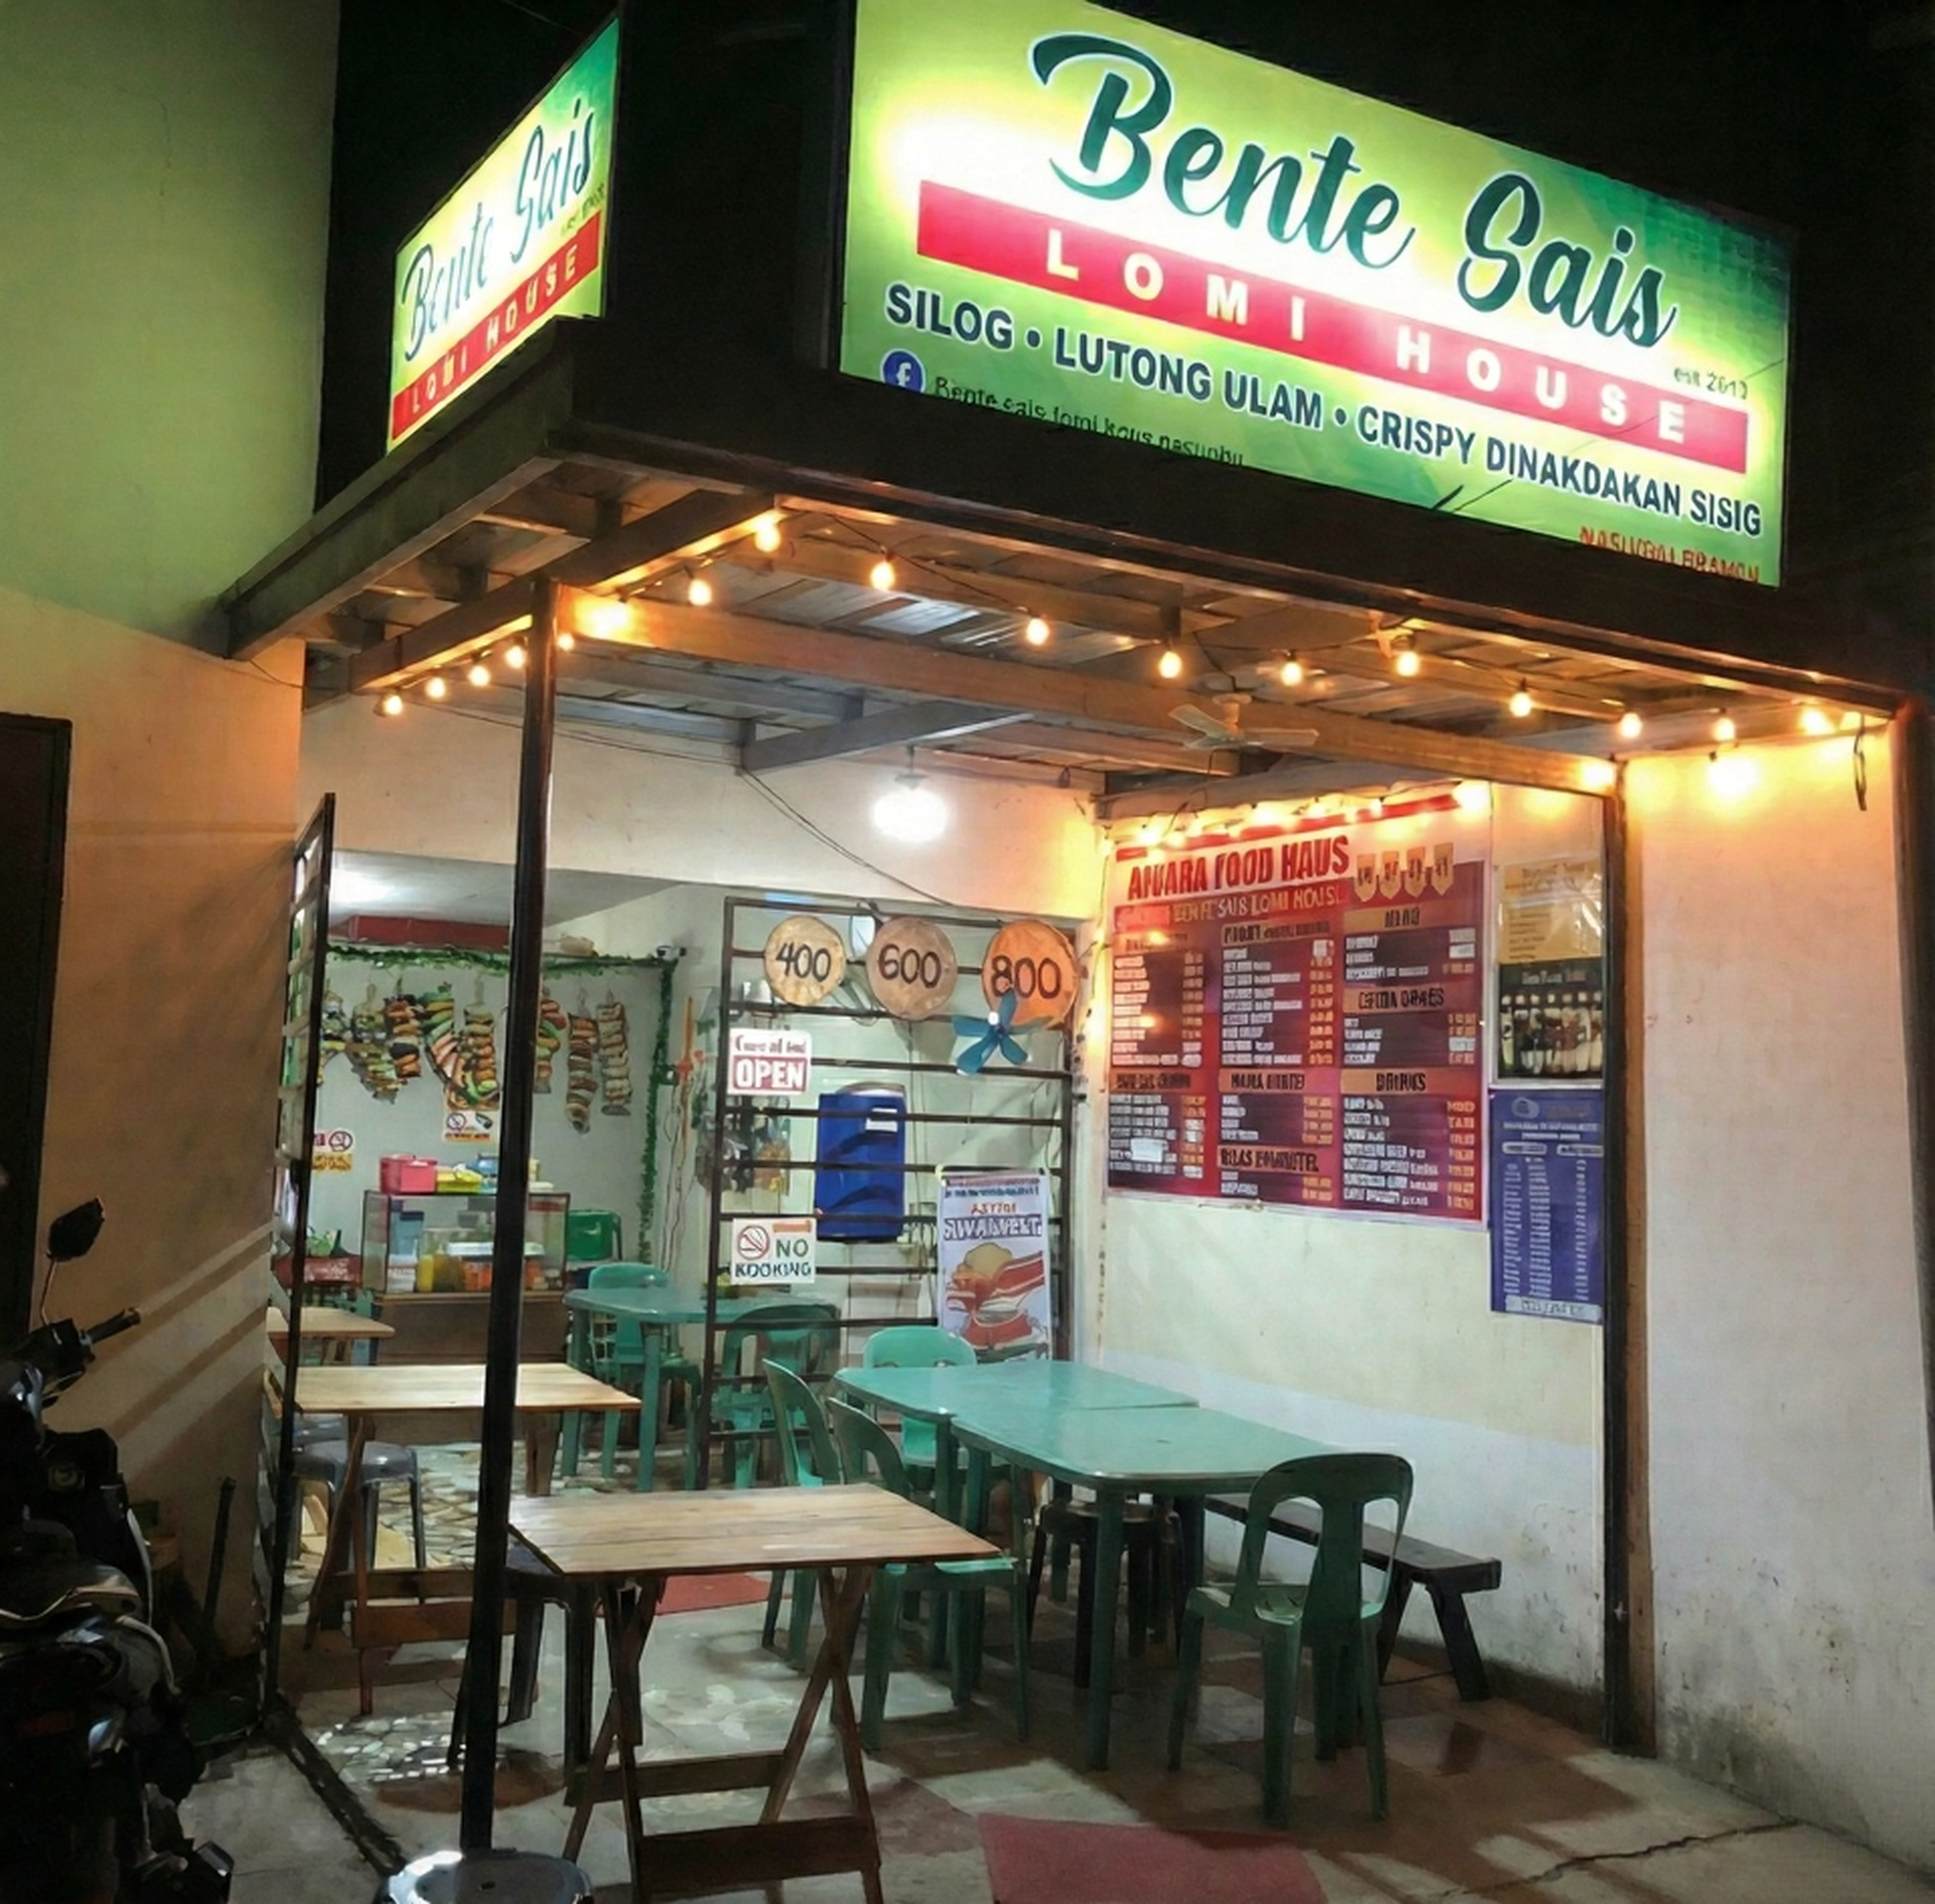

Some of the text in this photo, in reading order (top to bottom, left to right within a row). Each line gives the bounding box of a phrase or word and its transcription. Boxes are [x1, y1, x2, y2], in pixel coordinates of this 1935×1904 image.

[510, 98, 595, 265] Sais
[1030, 33, 1678, 348] Bente Sais
[486, 244, 580, 349] HOUSE
[1047, 228, 1685, 444] LOMI HOUSE
[886, 283, 1762, 537] SILOG LUTONG ULAM CRISPY DINAKDAKAN SISIG
[1280, 834, 1350, 881] HAUS
[775, 940, 1062, 999] 400 600 800
[736, 1057, 805, 1089] OPEN
[776, 1237, 810, 1259] NO
